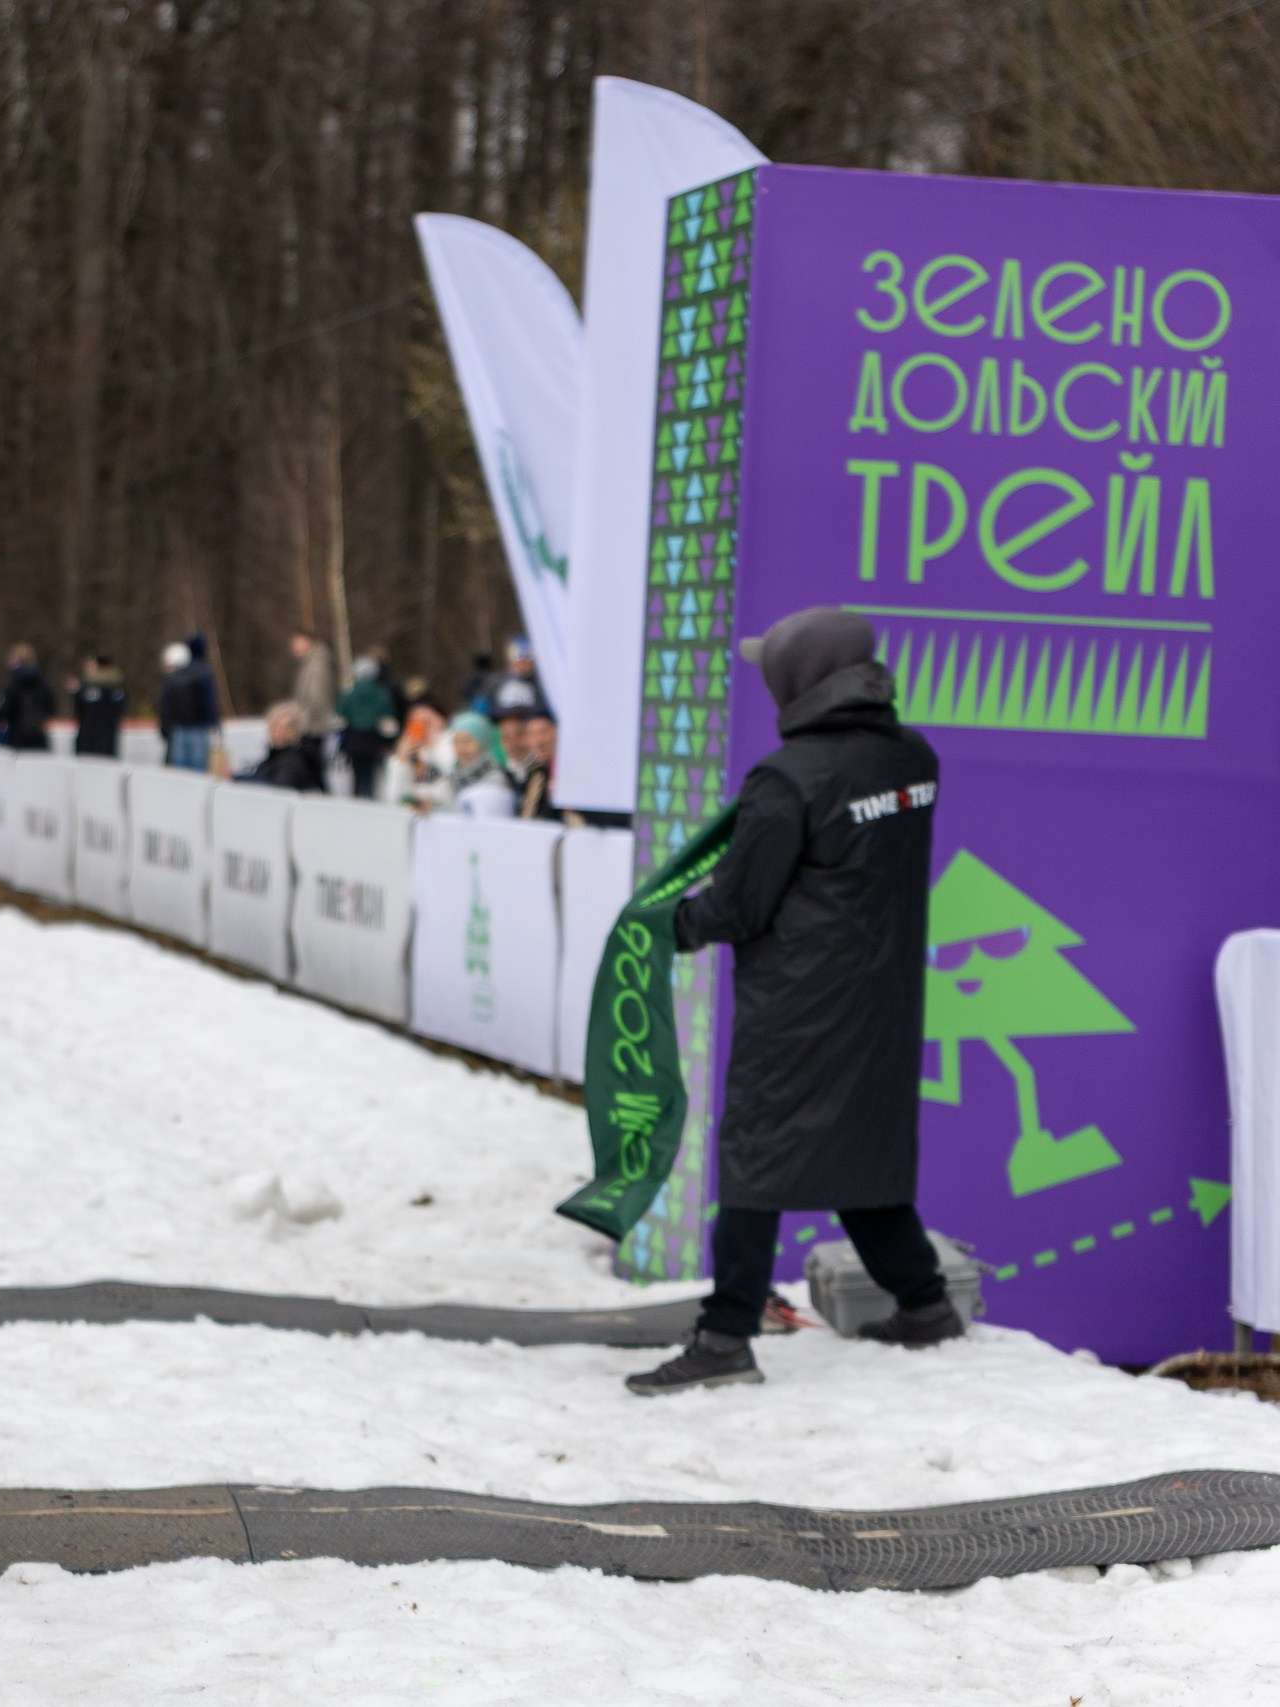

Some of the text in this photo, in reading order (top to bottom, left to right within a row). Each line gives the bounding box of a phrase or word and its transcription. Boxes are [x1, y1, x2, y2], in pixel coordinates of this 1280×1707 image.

[849, 352, 1227, 448] ДОЛЬСКИЙ
[847, 452, 1215, 599] ТРЕЙЛ
[612, 921, 654, 1077] 2026
